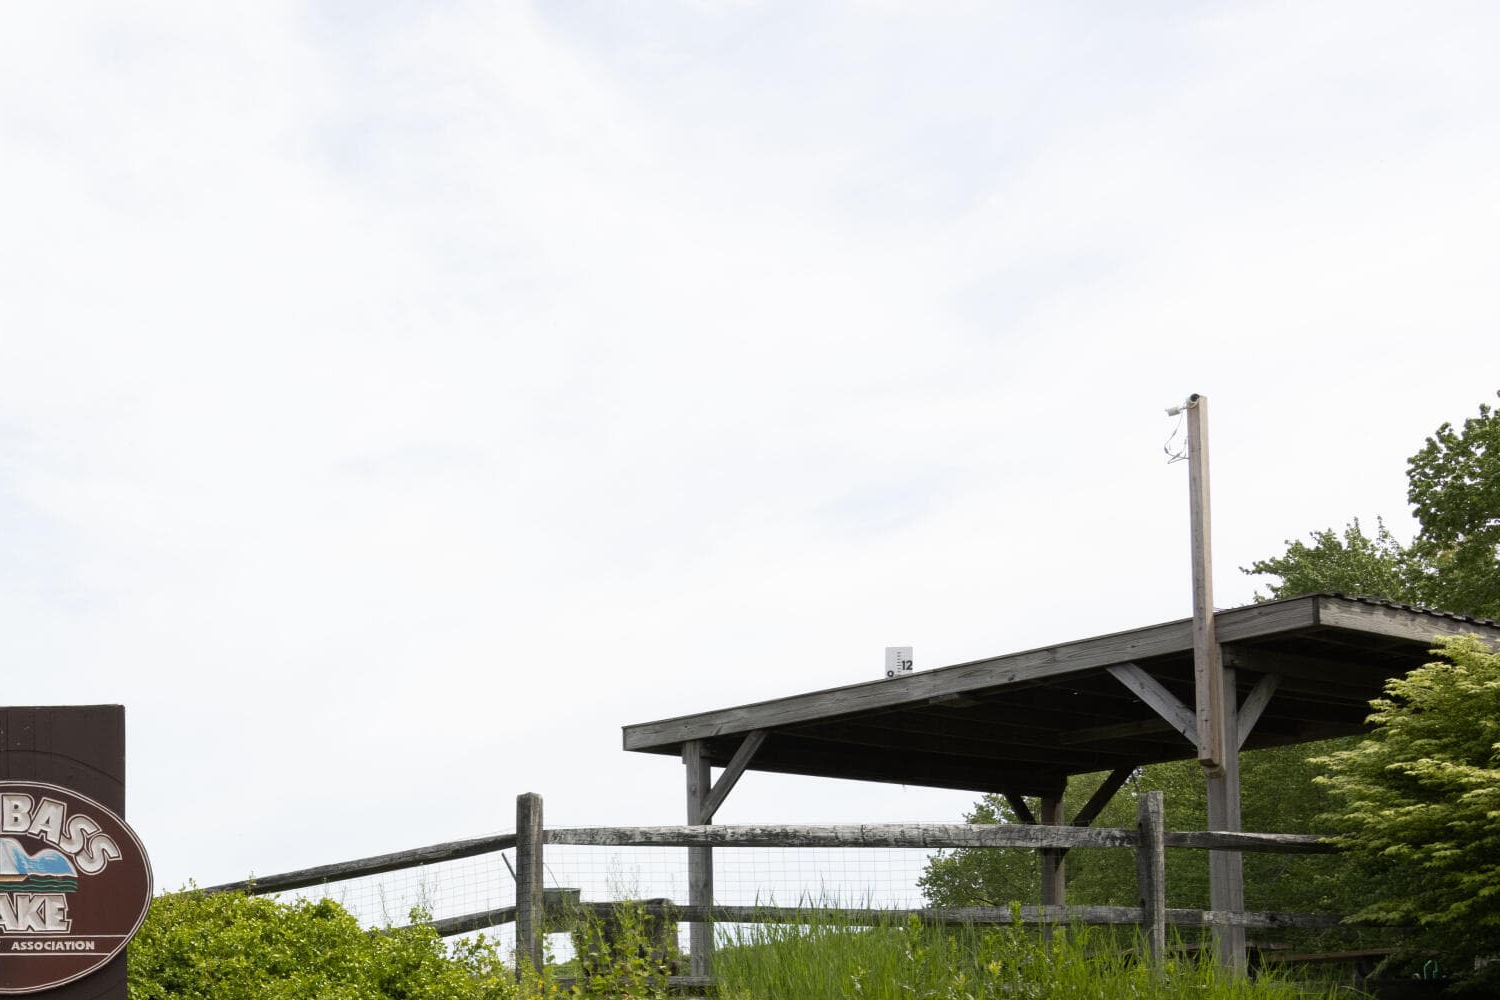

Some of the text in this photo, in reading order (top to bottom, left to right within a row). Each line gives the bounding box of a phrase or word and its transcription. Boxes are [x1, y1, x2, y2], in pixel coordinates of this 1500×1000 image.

[902, 660, 913, 670] 12
[0, 792, 122, 875] BASS
[11, 941, 95, 951] ASSOCIATION
